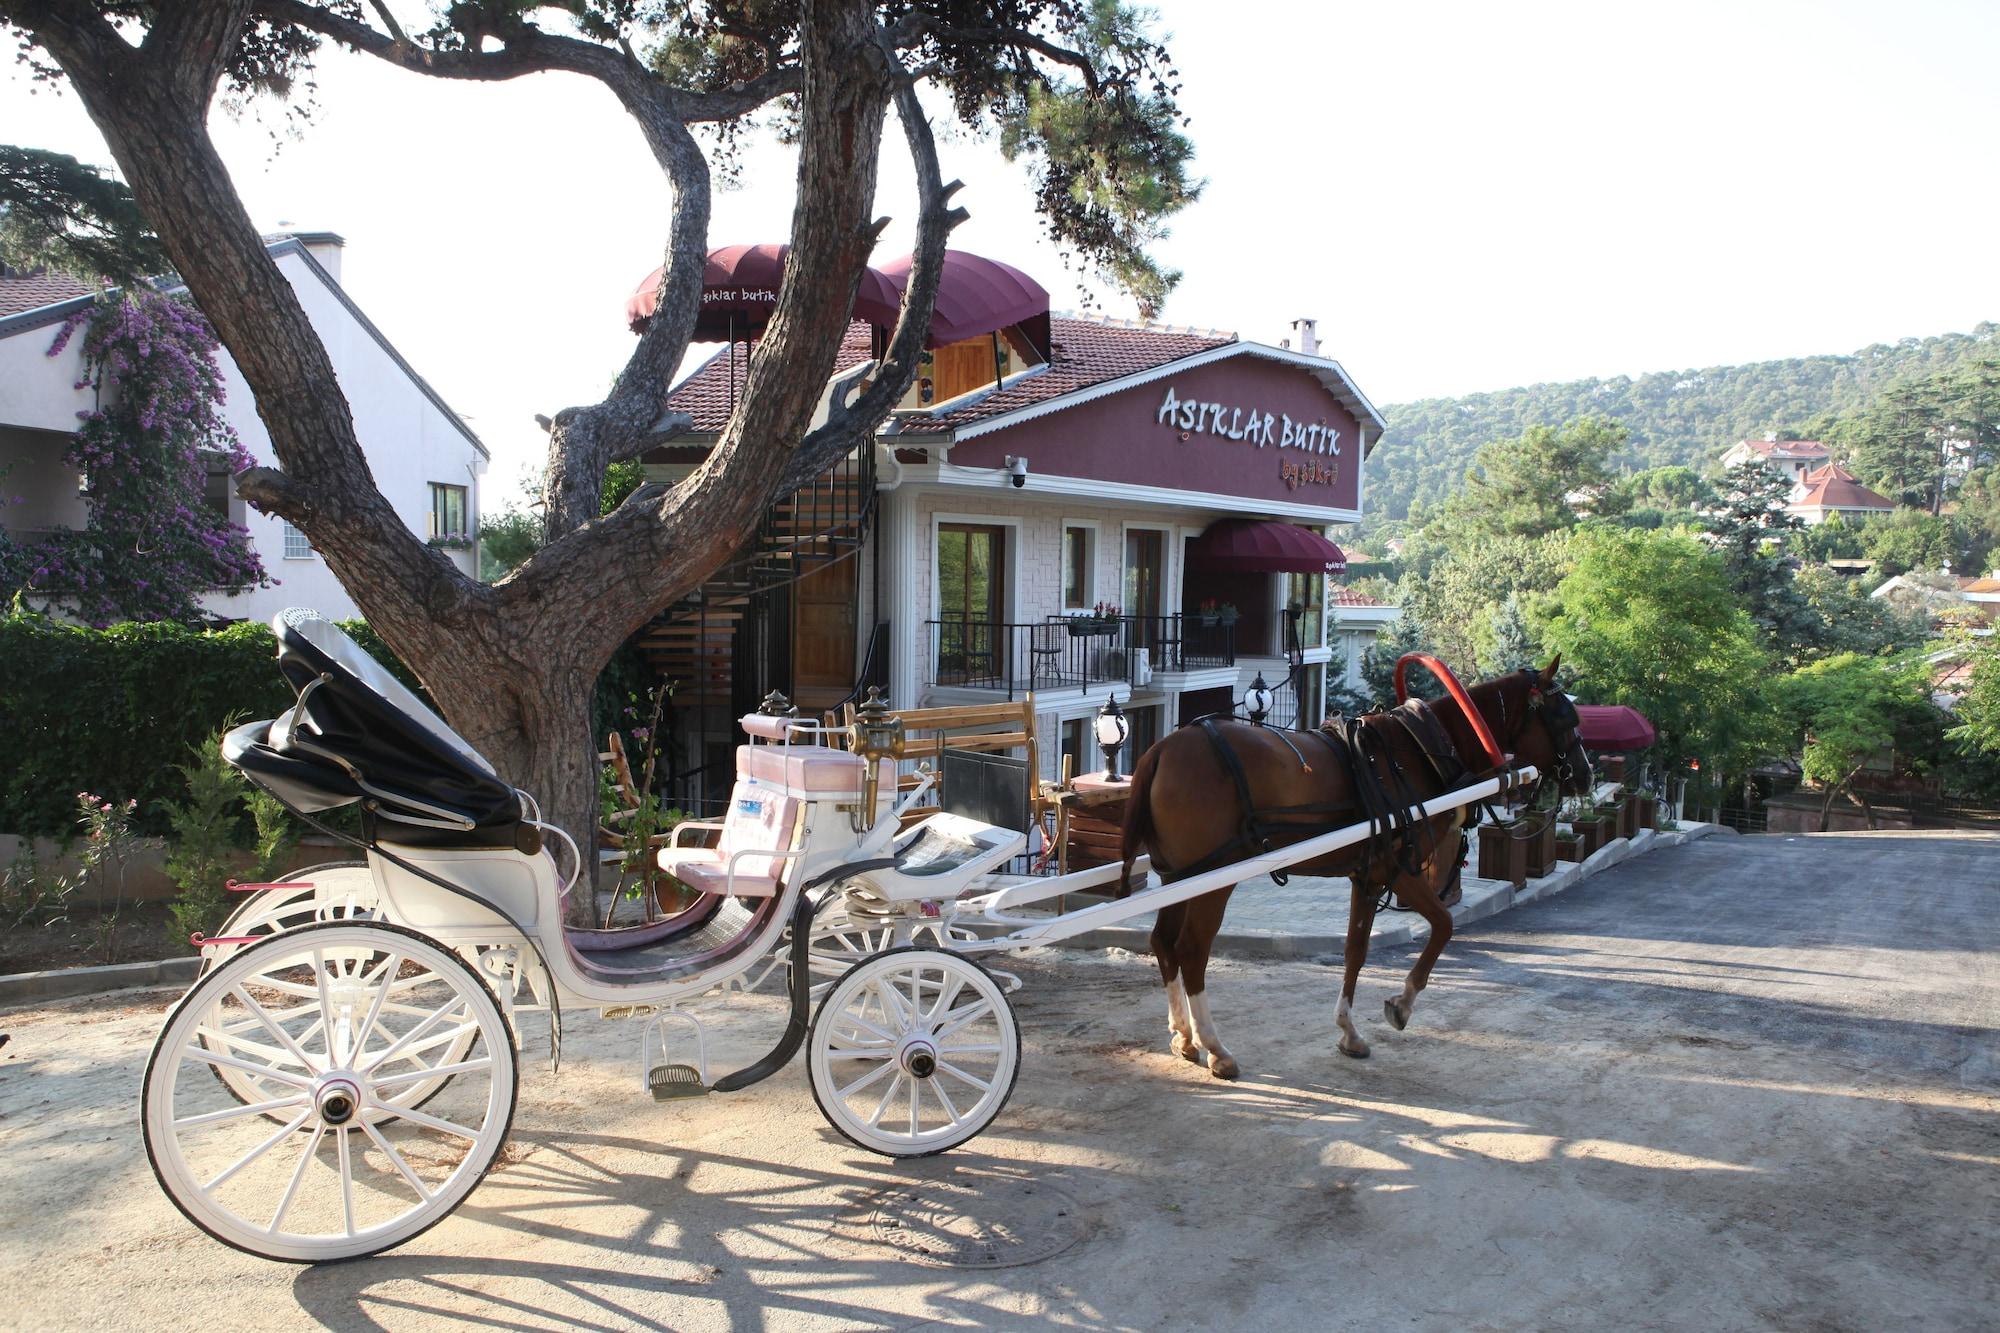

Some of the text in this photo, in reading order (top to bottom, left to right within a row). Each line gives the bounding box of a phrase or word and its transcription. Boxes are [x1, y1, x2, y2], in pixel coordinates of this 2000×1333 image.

[703, 288, 777, 303] şıklar butik
[1282, 456, 1298, 490] by
